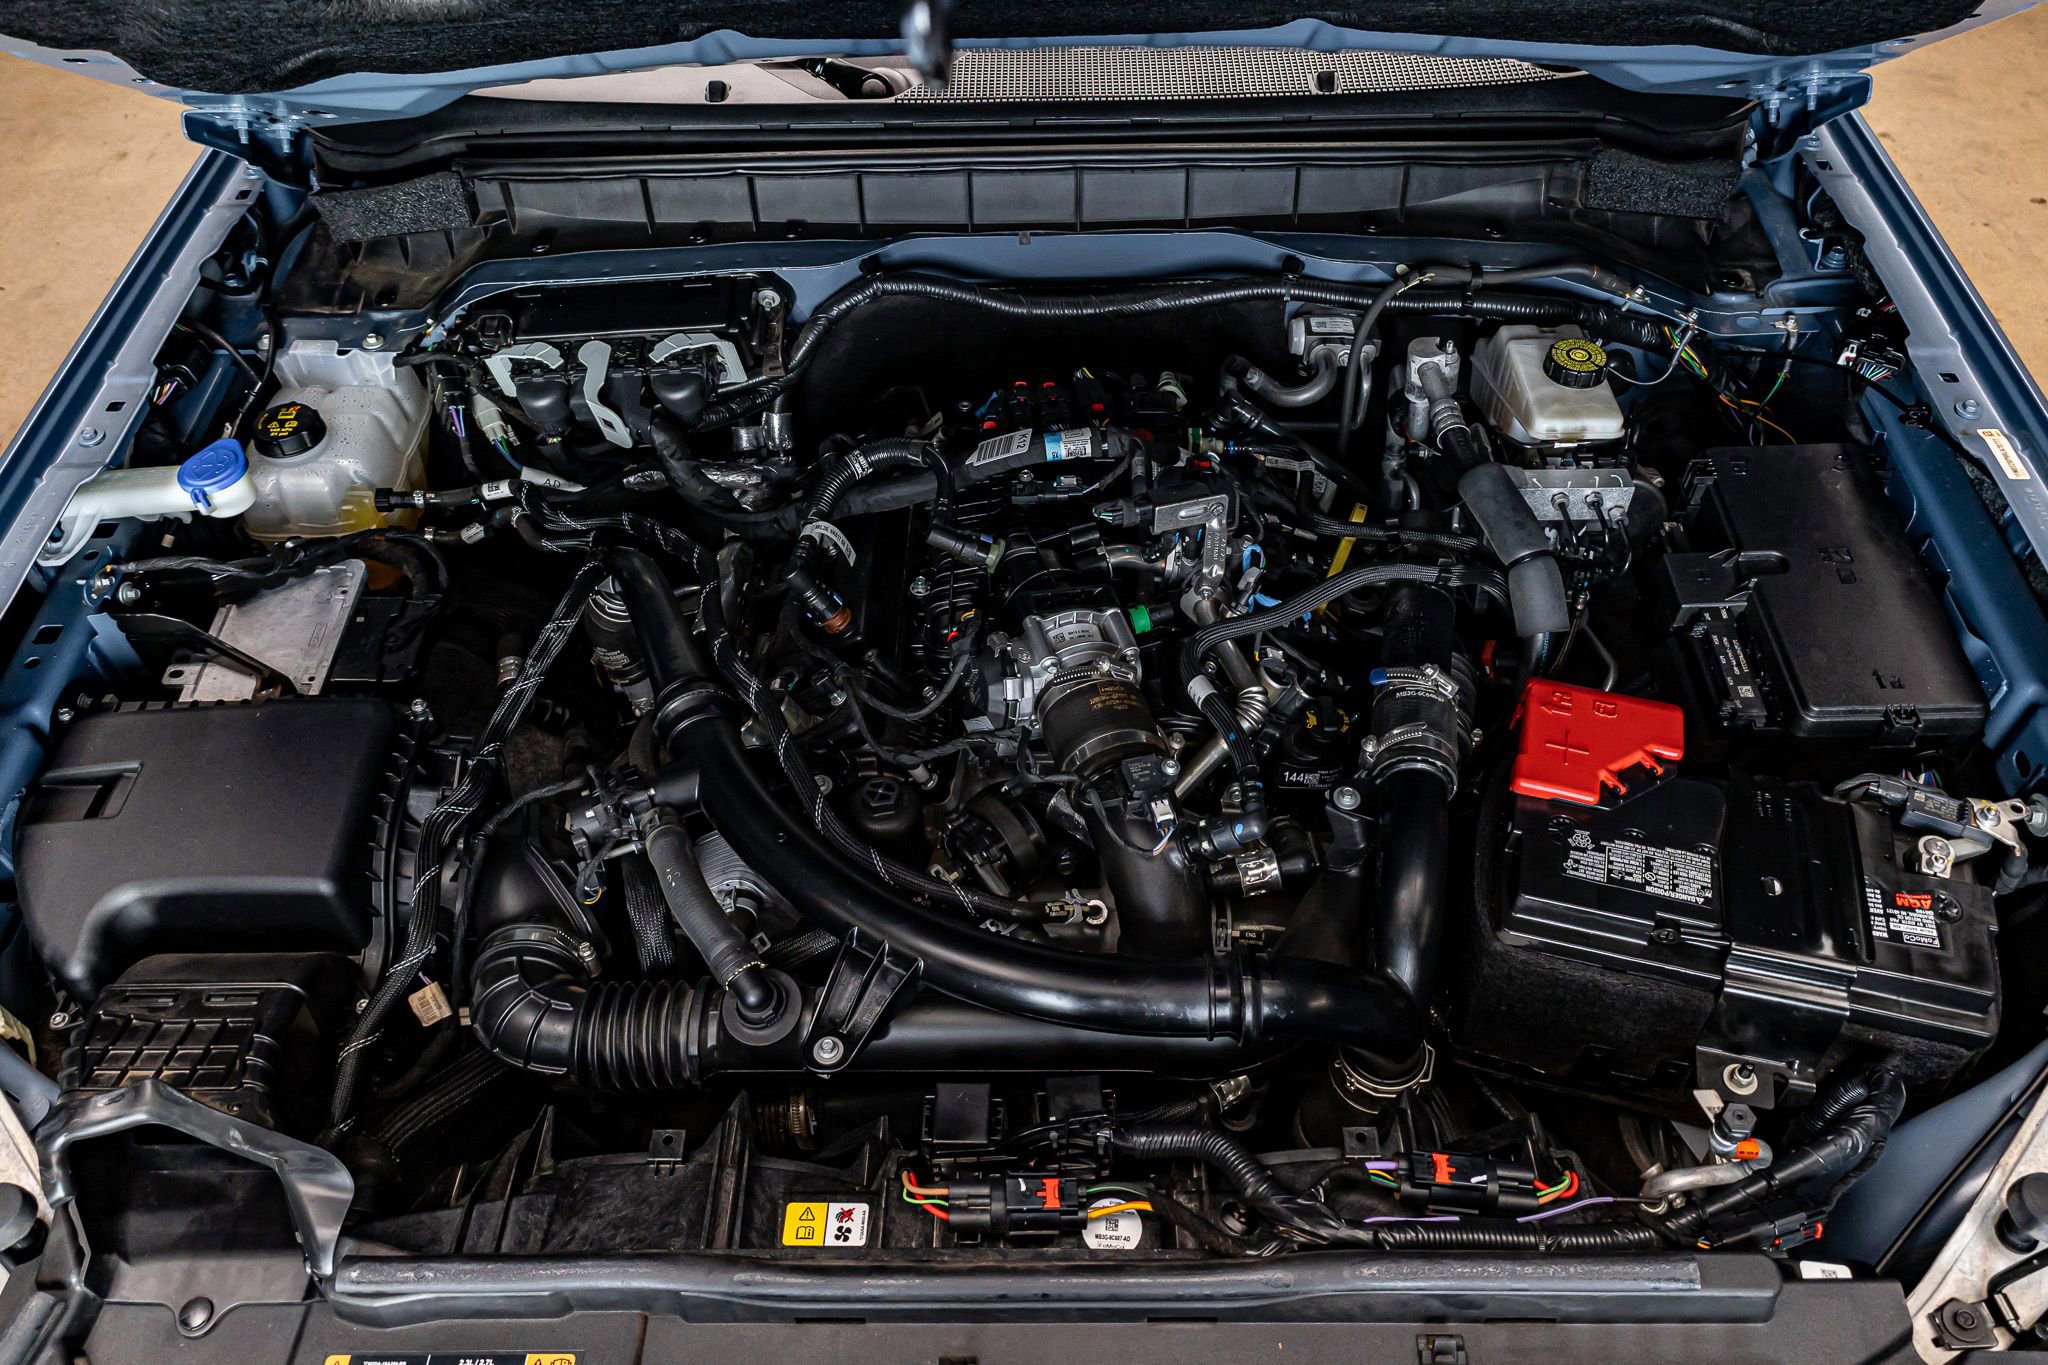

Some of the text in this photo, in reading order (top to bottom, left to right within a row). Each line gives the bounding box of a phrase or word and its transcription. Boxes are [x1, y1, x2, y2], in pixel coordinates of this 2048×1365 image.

[1016, 433, 1028, 450] K12
[544, 478, 560, 488] AD
[1645, 886, 1695, 902] DANGER/POISON
[1896, 897, 1932, 910] AGM
[1904, 934, 1938, 945] FoMoCo
